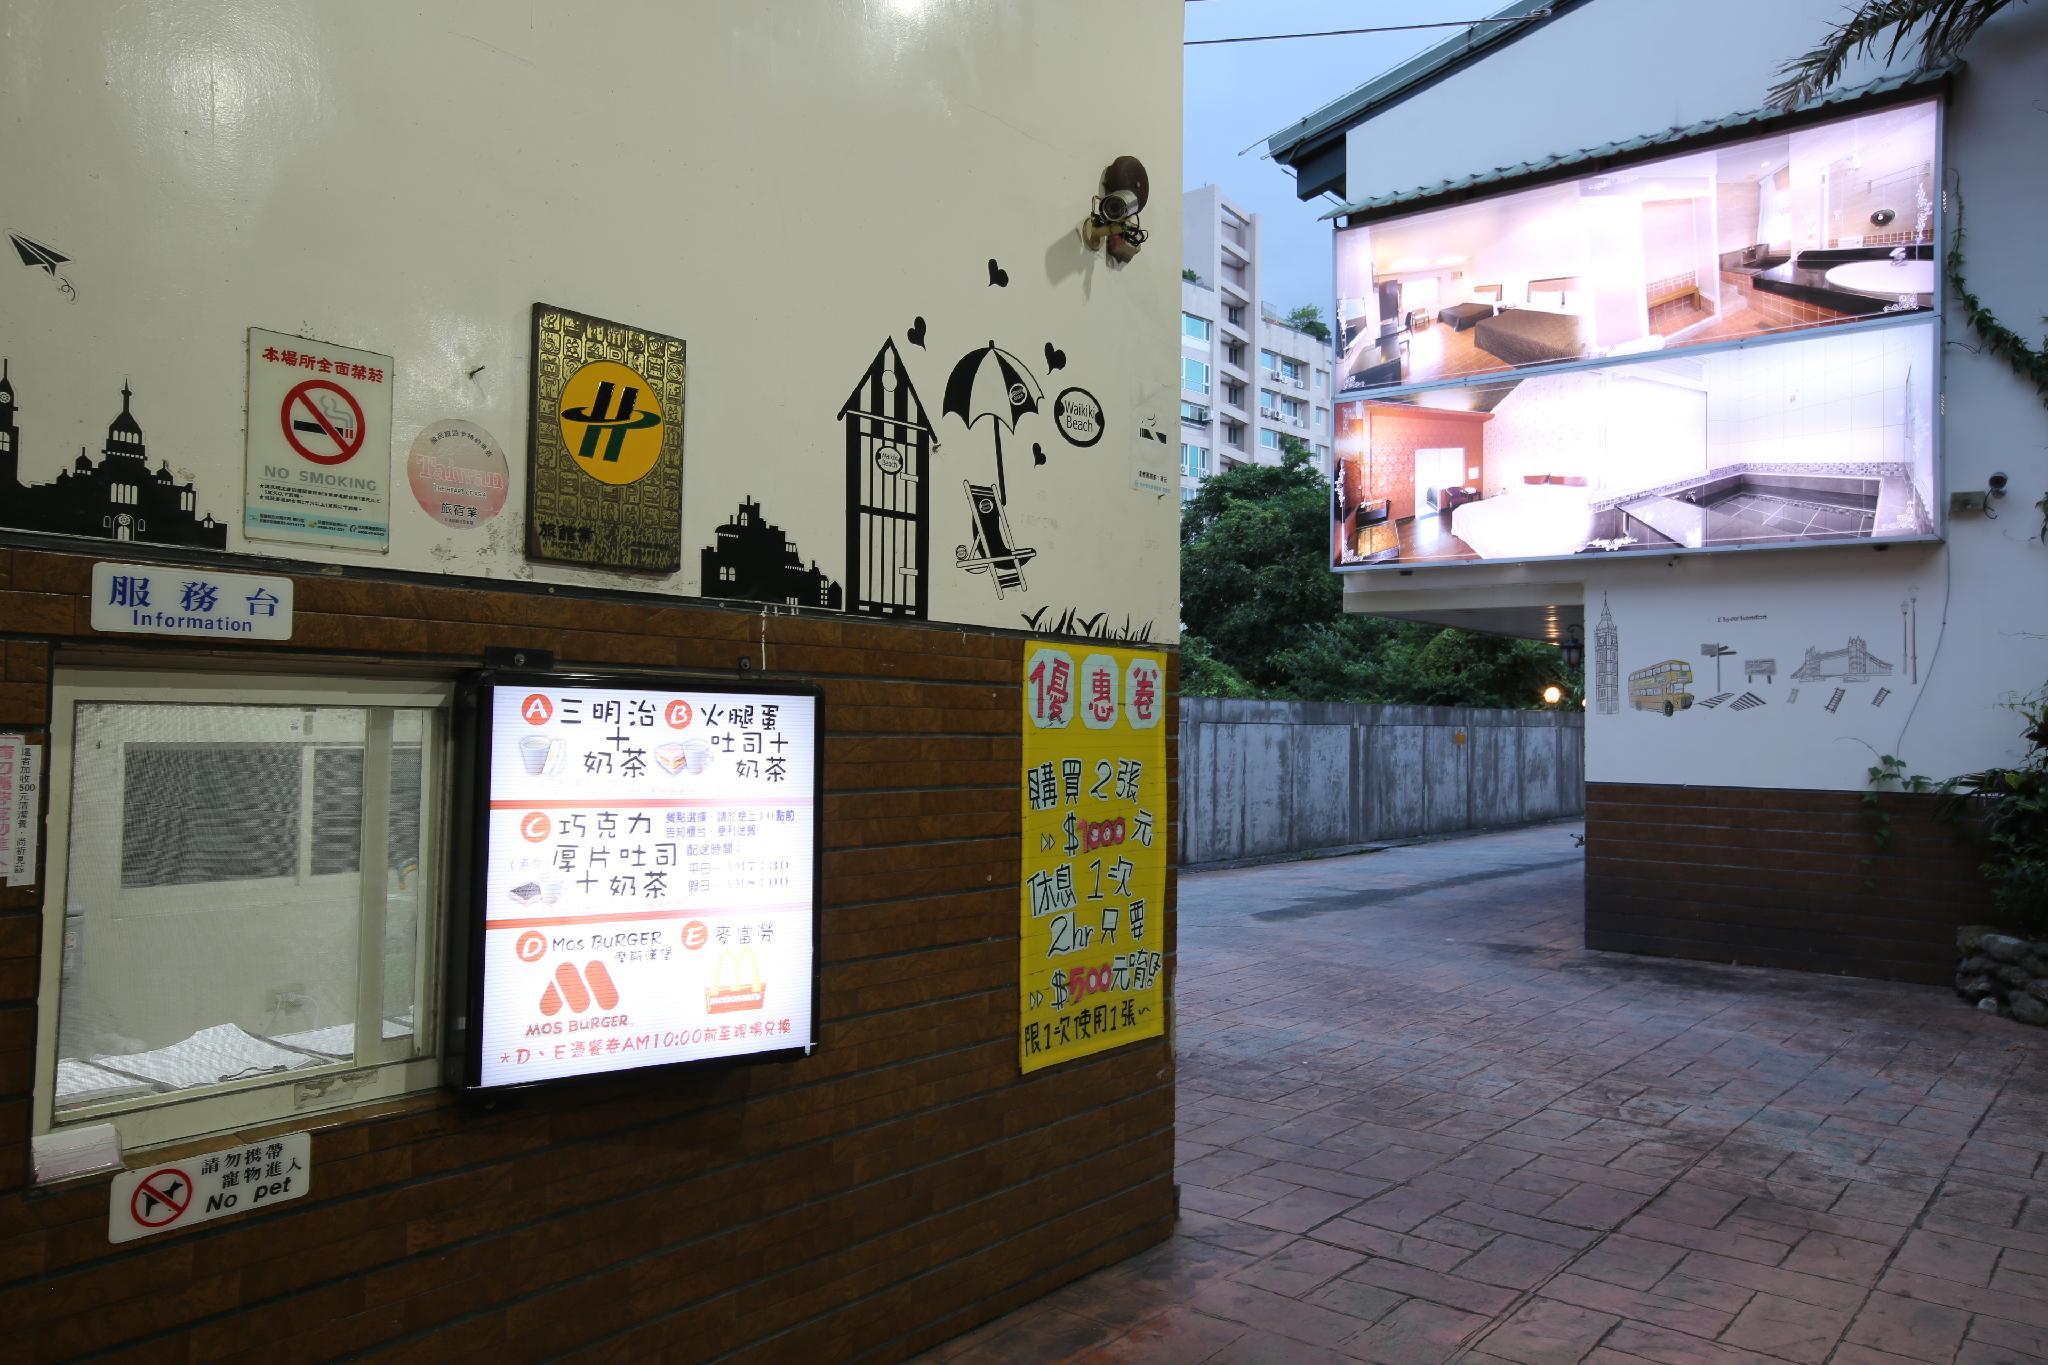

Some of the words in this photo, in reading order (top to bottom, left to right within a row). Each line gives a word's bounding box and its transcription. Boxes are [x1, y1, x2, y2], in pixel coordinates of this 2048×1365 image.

[262, 346, 384, 383] 本場所全面禁菸
[1064, 399, 1095, 419] Waikiki
[1066, 415, 1093, 432] Beach
[264, 465, 290, 479] NO
[299, 470, 377, 491] SMOKING
[415, 454, 504, 489] Taiwan
[109, 575, 279, 617] 服務台
[133, 610, 252, 632] Information
[526, 698, 548, 718] A
[560, 698, 656, 727] 三明治
[670, 703, 687, 725] B
[701, 703, 779, 731] 火腿蛋
[584, 748, 647, 778] 奶茶
[736, 757, 786, 782] 奶茶
[526, 816, 546, 838] C
[558, 811, 651, 839] 巧克力
[553, 843, 677, 873] 厚片吐司
[522, 937, 544, 958] D
[591, 931, 662, 949] BURGER
[687, 927, 704, 945] E
[525, 1023, 563, 1037] MOS
[568, 1014, 628, 1032] BURGER
[201, 1142, 283, 1175] 請勿攜帶
[222, 1157, 302, 1189] 寵物進入
[205, 1192, 237, 1213] No
[253, 1176, 291, 1202] pet
